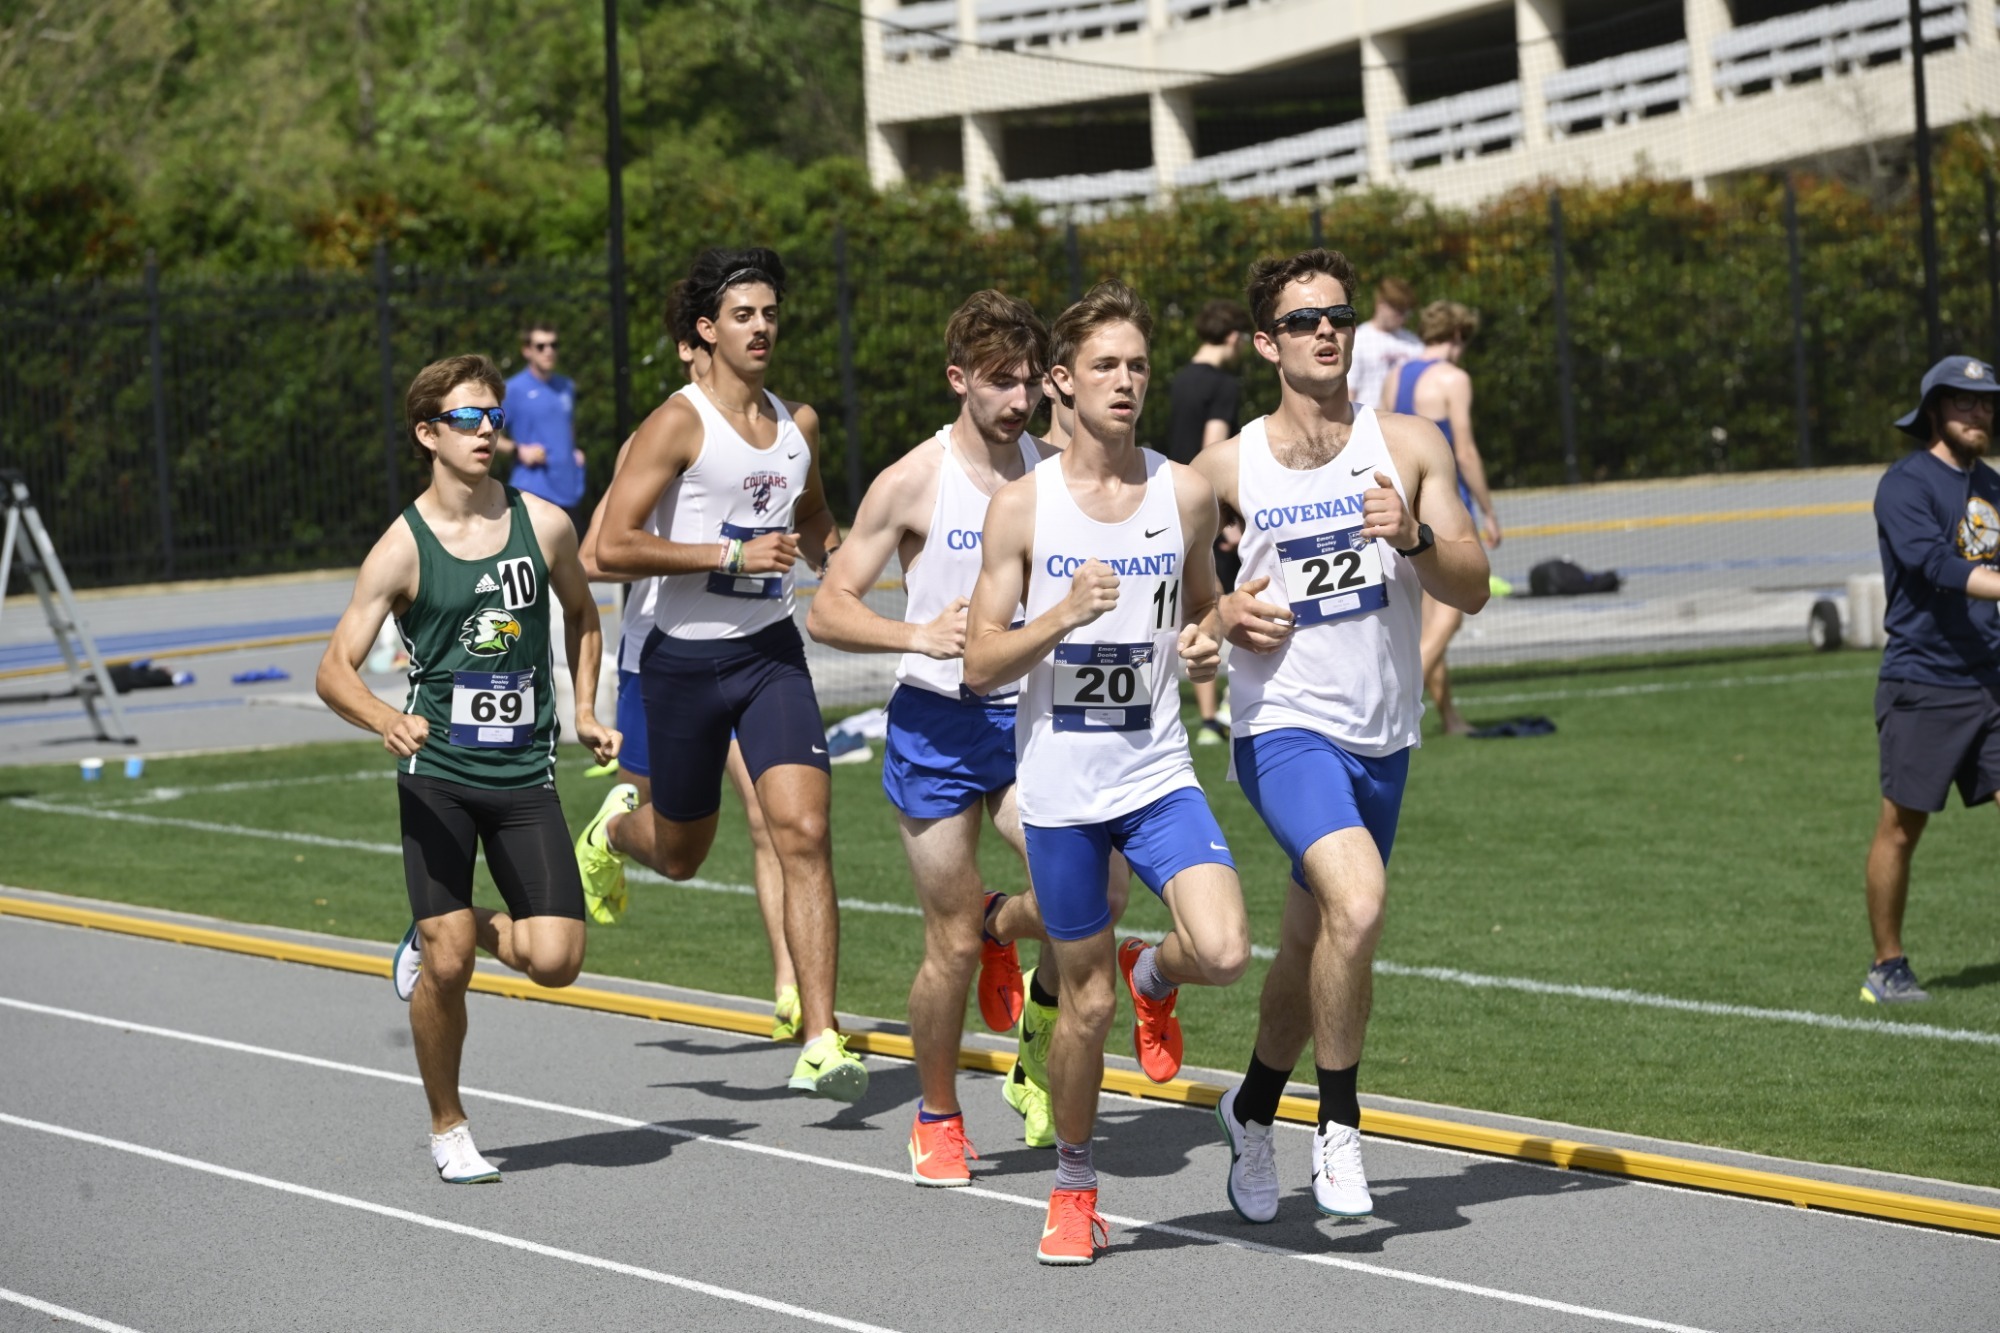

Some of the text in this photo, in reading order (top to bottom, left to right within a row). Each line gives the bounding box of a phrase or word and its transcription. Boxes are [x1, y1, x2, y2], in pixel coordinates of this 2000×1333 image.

[743, 475, 787, 490] COUGARS
[1254, 494, 1363, 531] COVENAN
[502, 561, 534, 606] 10
[1046, 553, 1176, 578] CONANT
[1302, 551, 1366, 596] 22
[475, 585, 500, 593] adidas
[1154, 579, 1178, 629] 11
[1074, 667, 1135, 704] 20
[471, 692, 522, 724] 69
